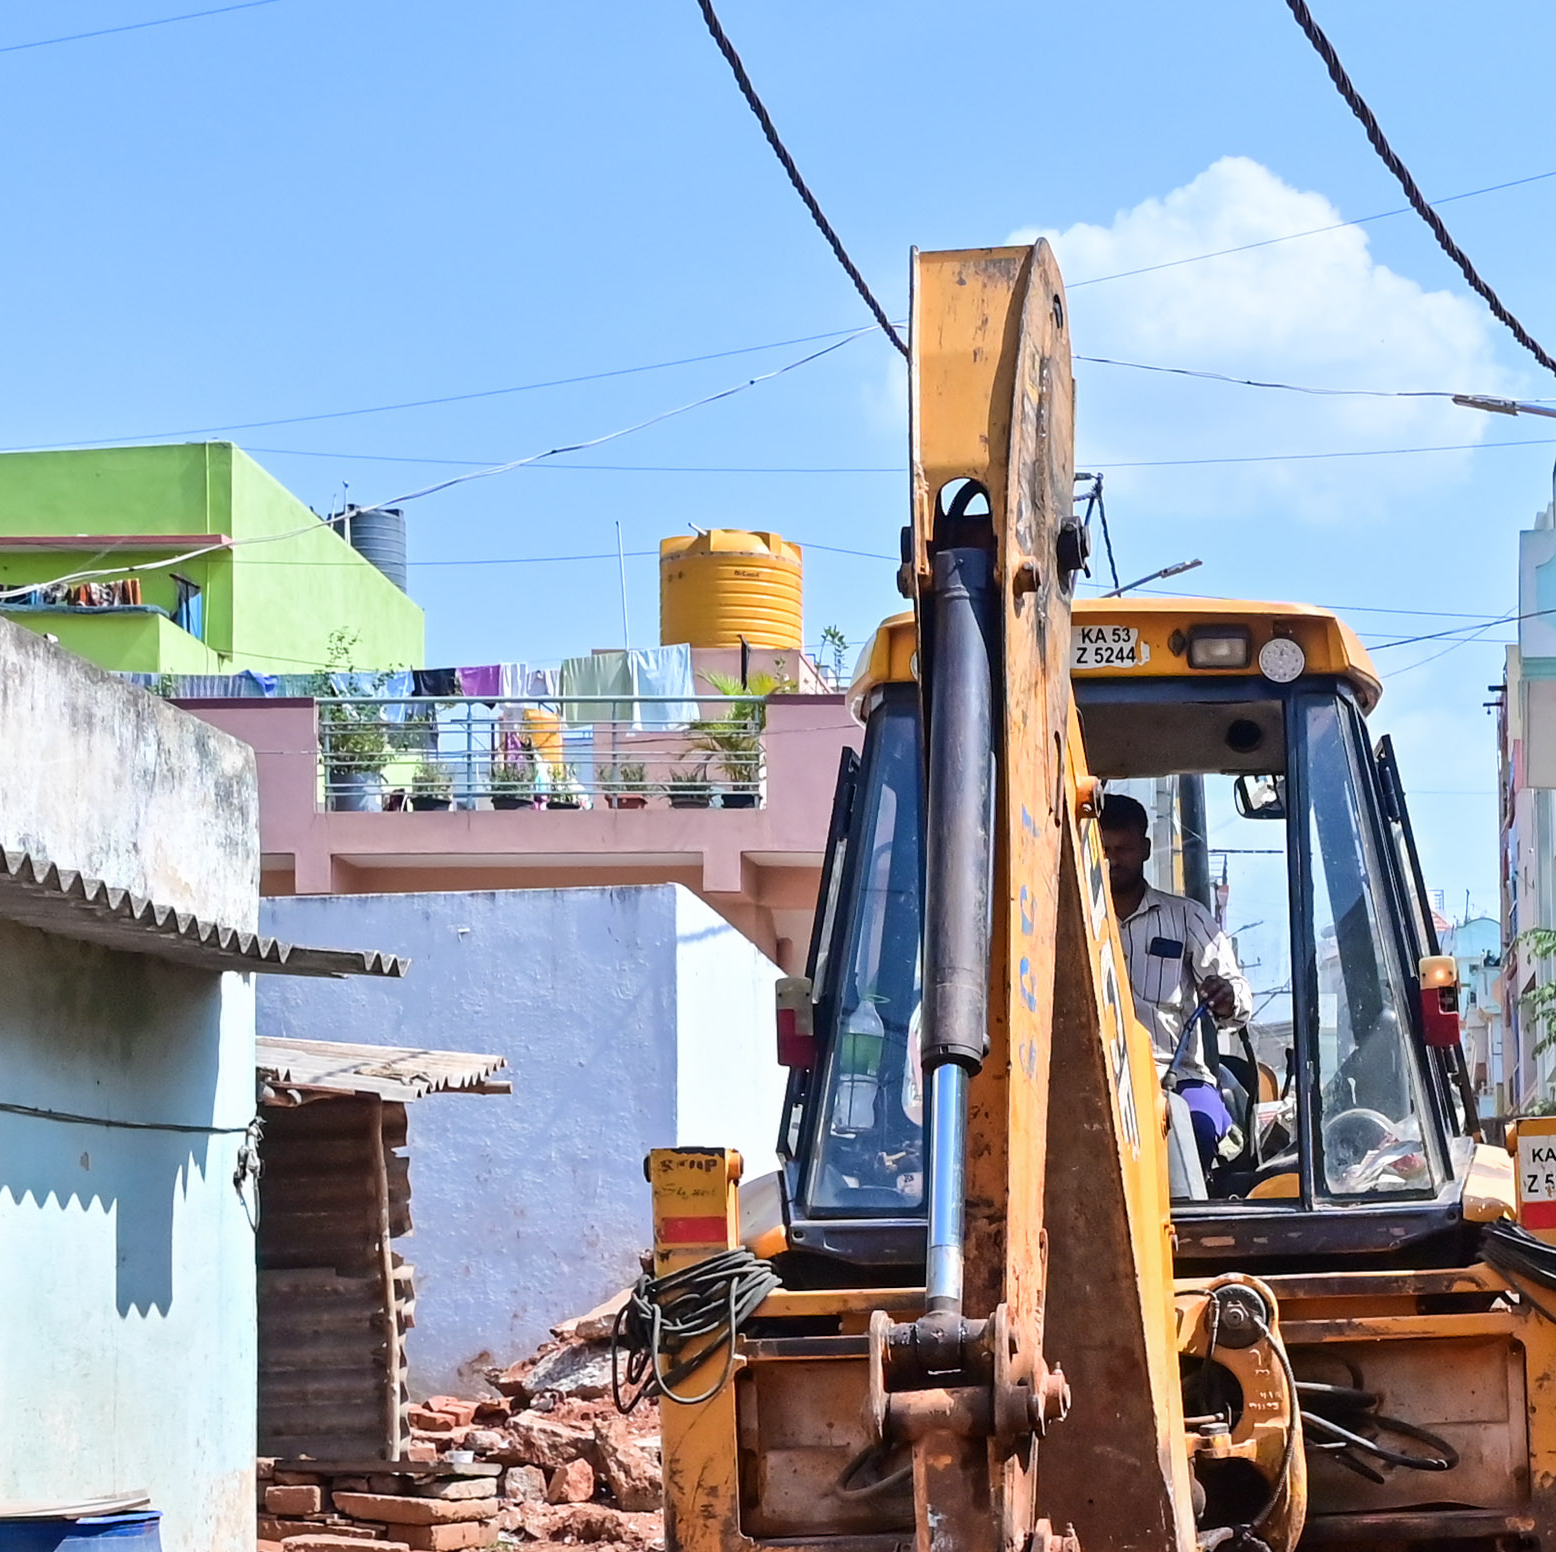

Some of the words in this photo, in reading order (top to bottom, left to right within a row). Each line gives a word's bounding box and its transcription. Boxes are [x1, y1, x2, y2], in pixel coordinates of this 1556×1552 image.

[1081, 628, 1107, 645] KA
[1112, 627, 1131, 643] 53
[1076, 647, 1088, 664] Z
[1094, 646, 1137, 664] 5244
[1532, 1148, 1556, 1163] KA
[1527, 1174, 1539, 1193] Z
